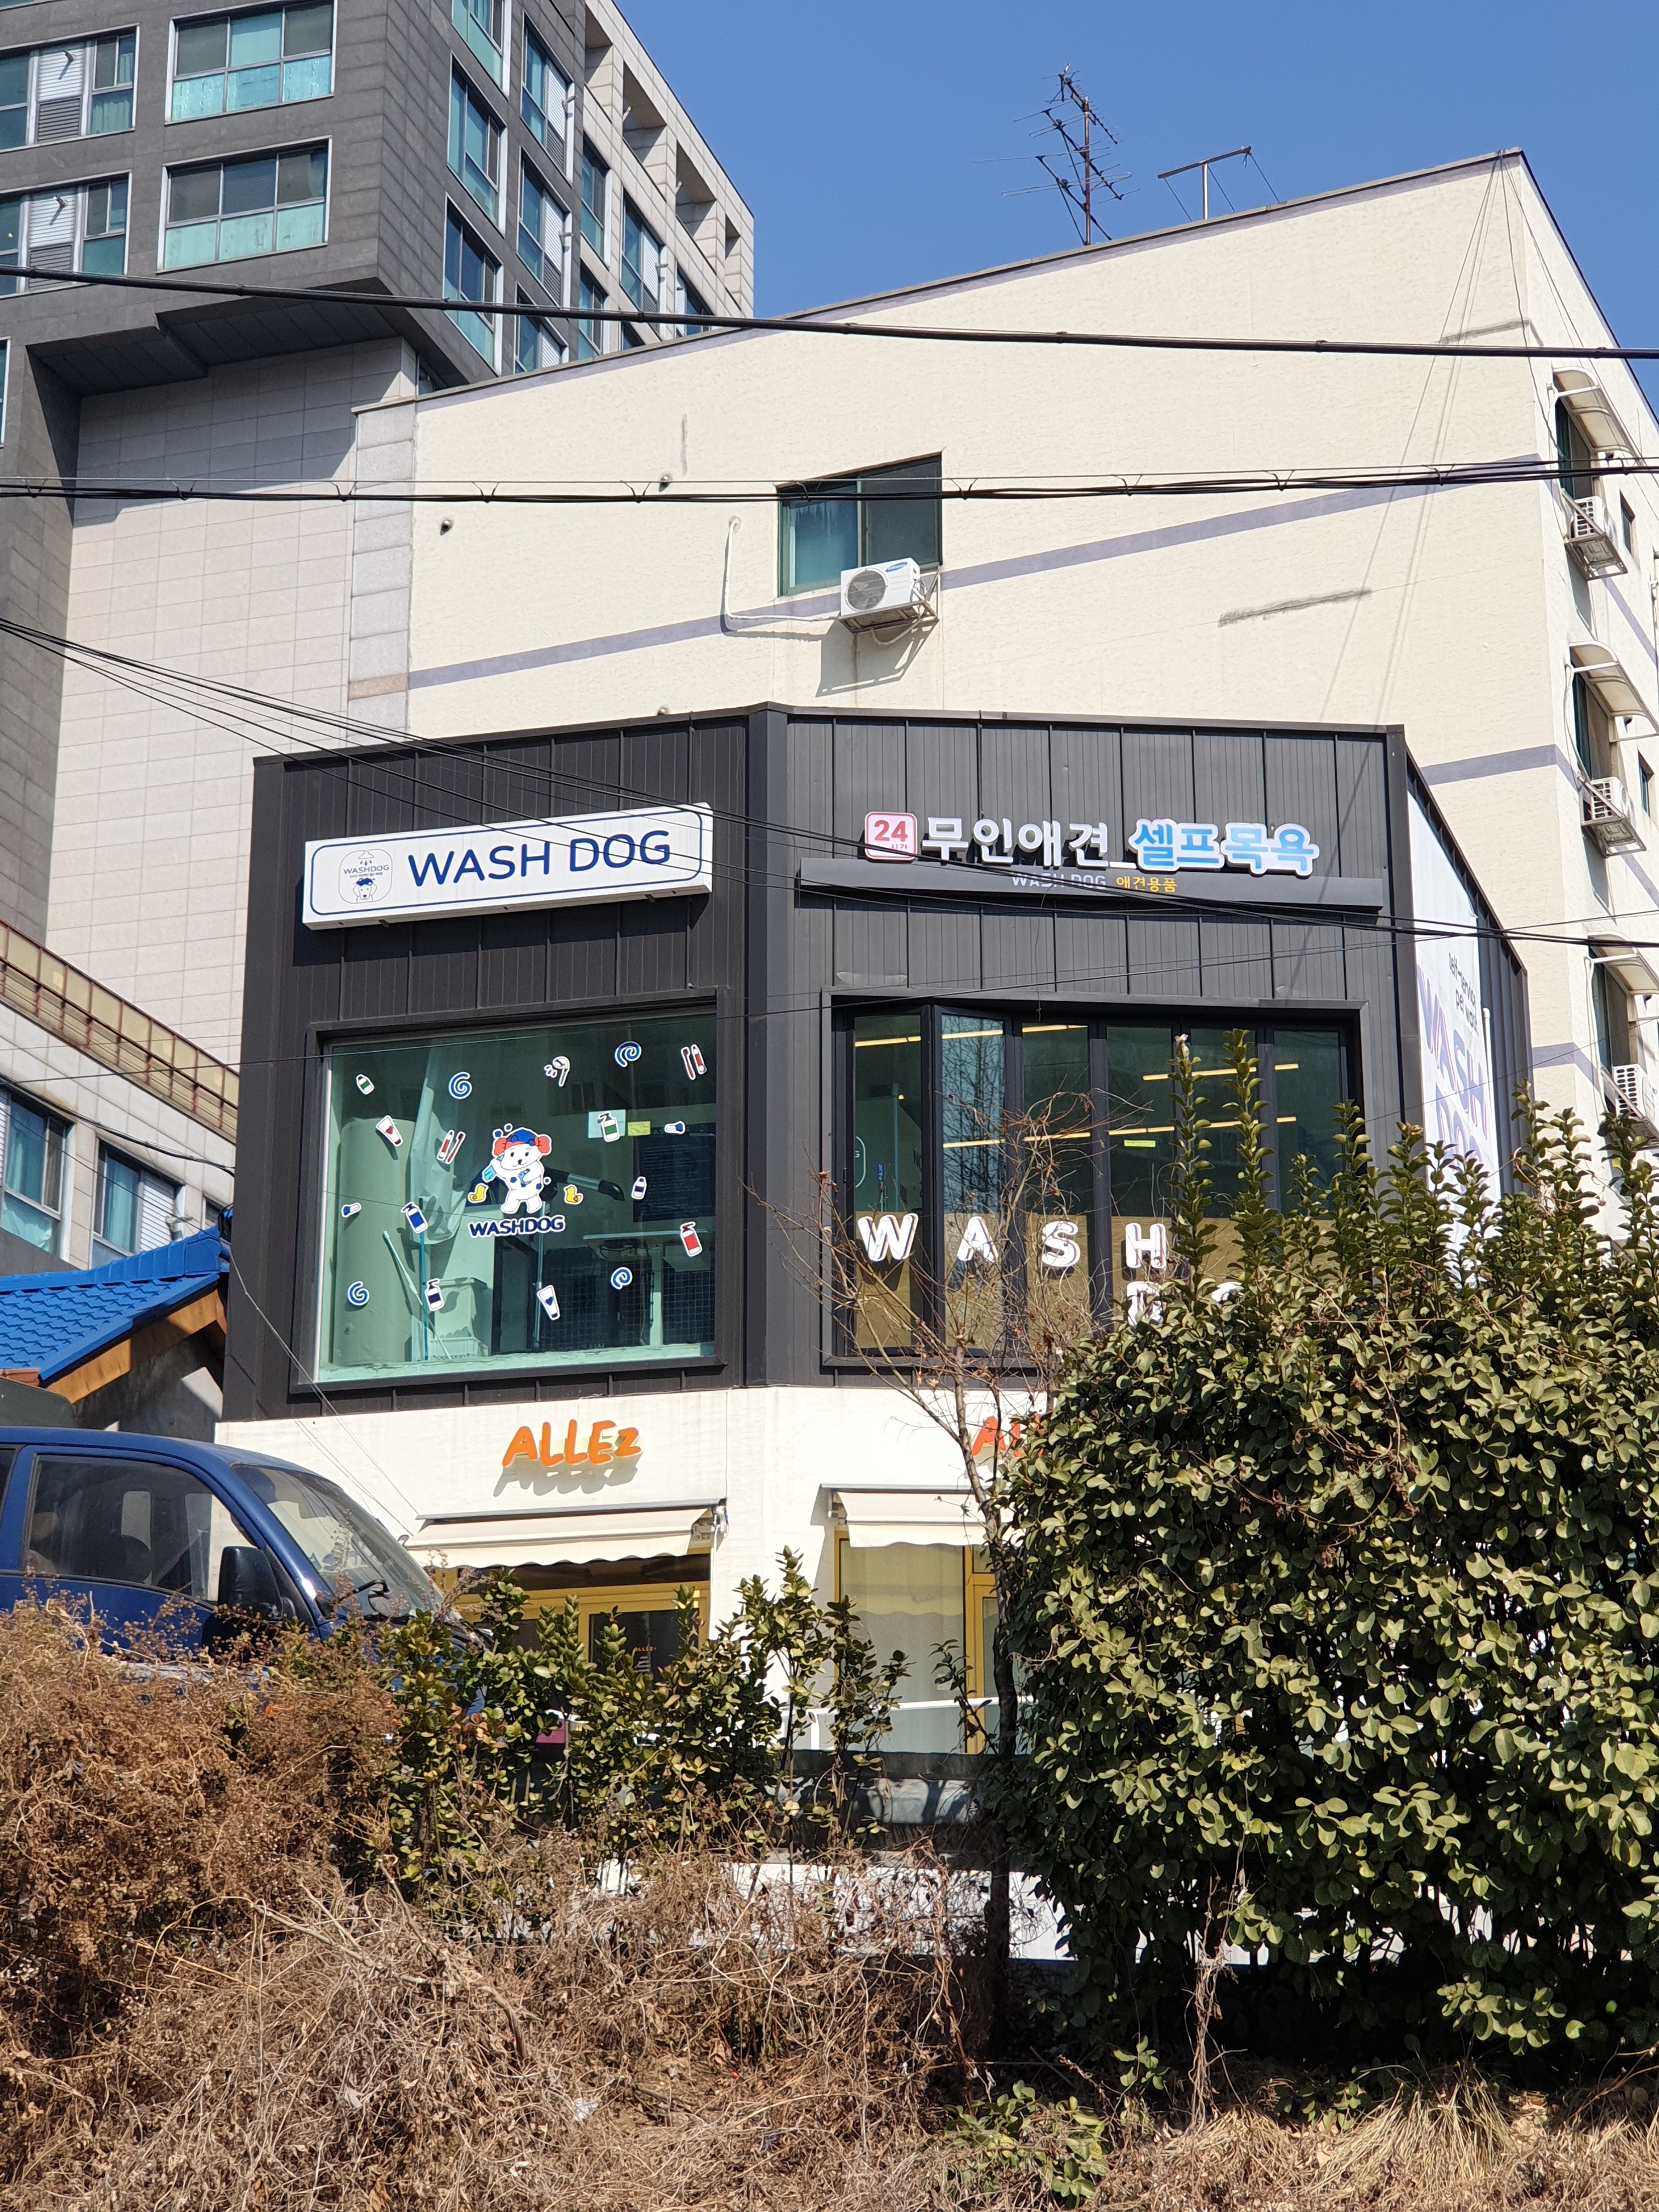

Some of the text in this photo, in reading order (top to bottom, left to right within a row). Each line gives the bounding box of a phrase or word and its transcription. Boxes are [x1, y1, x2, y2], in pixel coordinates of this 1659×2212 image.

[874, 820, 908, 842] 24
[922, 816, 1314, 872] 무인애견 셀프목욕
[343, 864, 390, 874] WASHDOG
[408, 829, 671, 886] WASH DOG
[1012, 872, 1177, 893] WASH DOG 애견용품
[1417, 963, 1487, 1141] WASH
[470, 1216, 564, 1237] WASHDOG
[857, 1212, 1167, 1269] WASH
